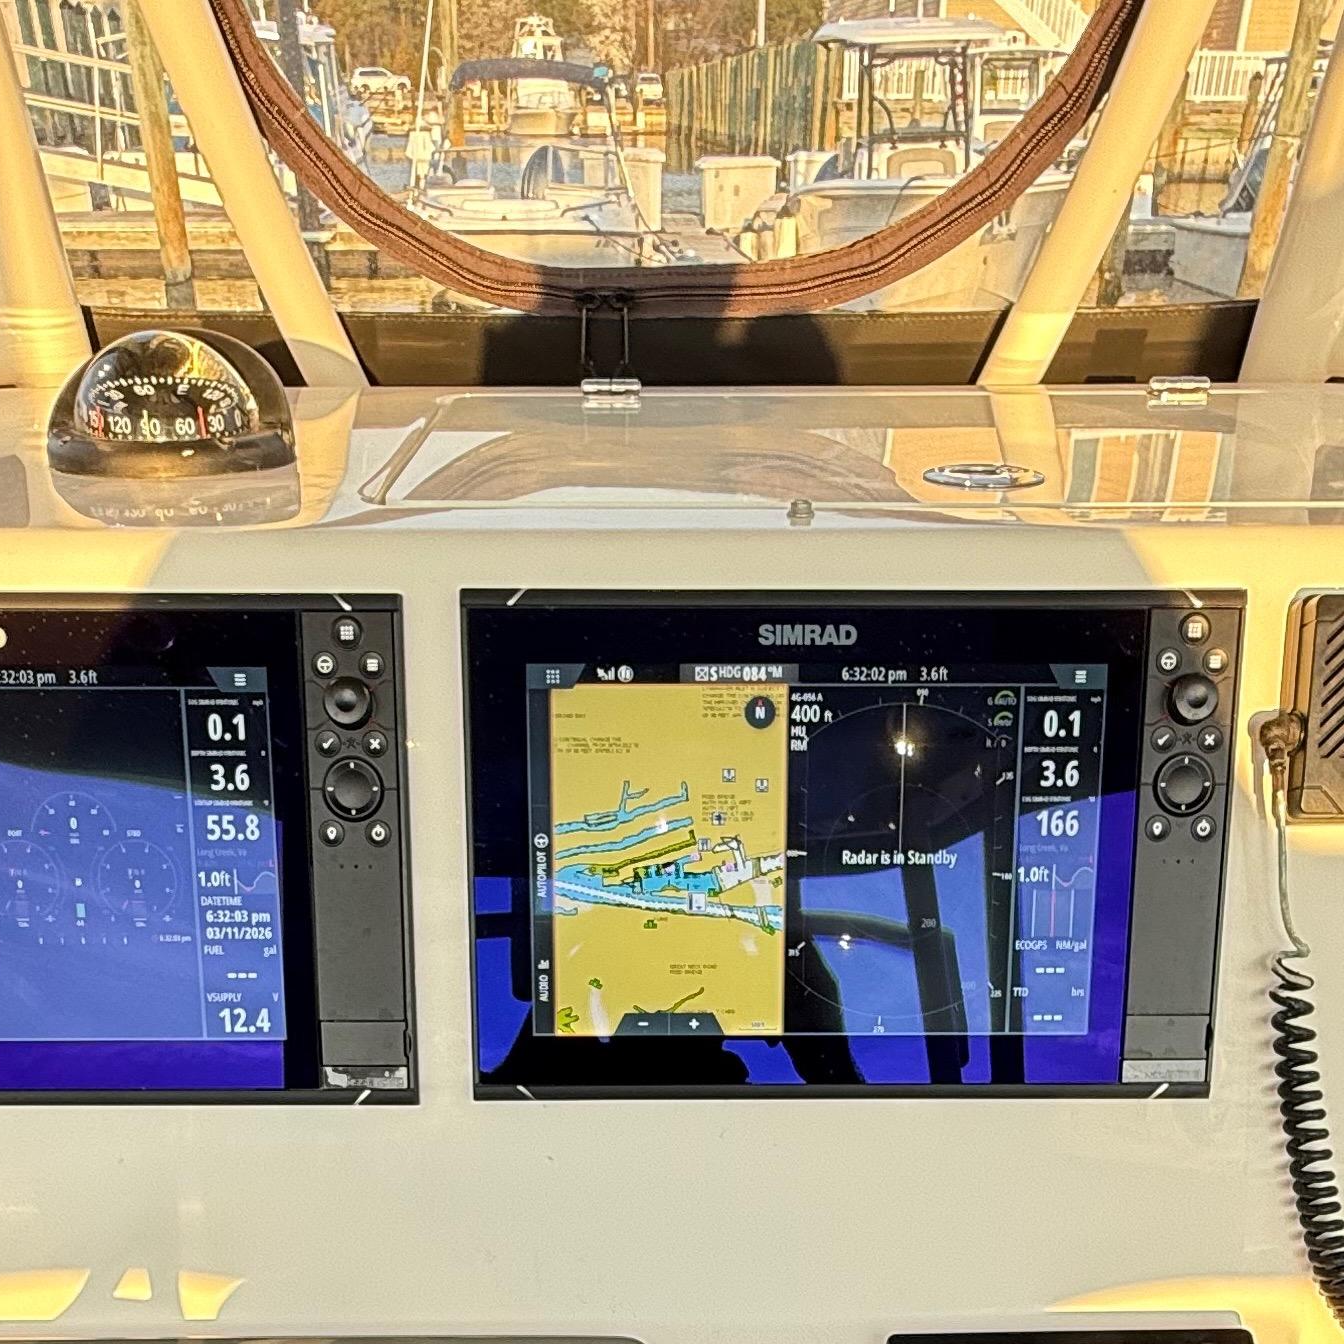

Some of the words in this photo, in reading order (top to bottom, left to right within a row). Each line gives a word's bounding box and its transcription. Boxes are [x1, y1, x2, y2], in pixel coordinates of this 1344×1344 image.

[108, 417, 131, 432] 120
[176, 419, 195, 435] 60
[208, 416, 224, 430] 30
[758, 624, 857, 646] SIMRAD
[37, 672, 56, 687] pm
[719, 666, 741, 678] HDG
[842, 667, 886, 681] 6:32:02
[888, 669, 906, 683] pm
[756, 708, 765, 719] N
[791, 705, 820, 722] 400
[824, 710, 832, 722] ft
[208, 713, 246, 741] 0.1
[1044, 710, 1081, 737] 0.1
[210, 764, 250, 791] 3.6
[1040, 760, 1079, 787] 3.6
[207, 815, 260, 840] 55.8
[1037, 810, 1079, 836] 166
[842, 851, 878, 865] Radar
[881, 851, 890, 864] is
[893, 850, 904, 864] in
[908, 850, 957, 868] Standby
[537, 852, 547, 897] AUTOPILOT
[201, 896, 242, 906] DATETIME
[206, 911, 248, 922] 6:32:03
[252, 912, 270, 925] pm
[207, 927, 272, 939] 03/11/2026
[204, 946, 224, 955] FUEL
[264, 945, 276, 957] gal
[1016, 940, 1047, 950] ECOGPS
[540, 975, 549, 1001] AUDIO
[207, 993, 241, 1002] VSUPPLY
[219, 1008, 270, 1032] 12.4
